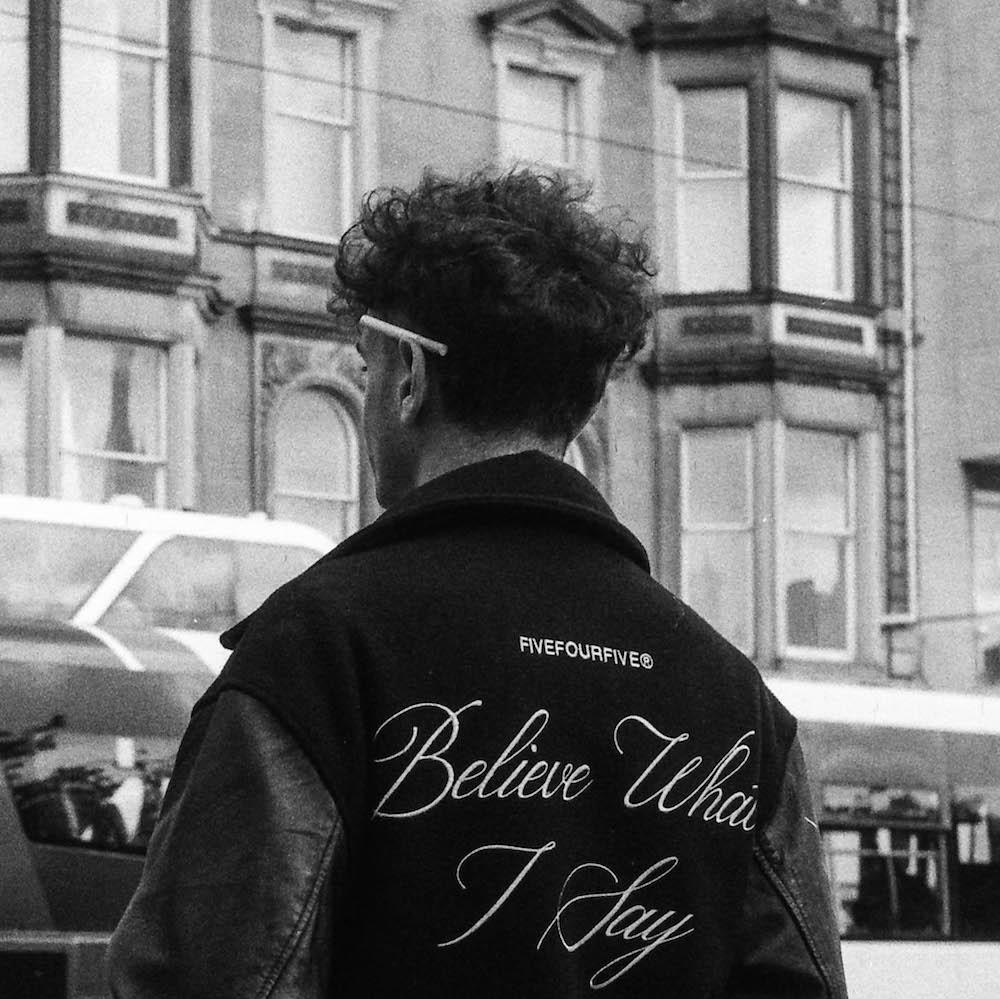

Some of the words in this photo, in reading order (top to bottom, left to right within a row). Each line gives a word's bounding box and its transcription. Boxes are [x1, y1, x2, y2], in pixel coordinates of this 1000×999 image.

[371, 700, 594, 820] Believe
[437, 841, 556, 947] I
[537, 857, 694, 990] Say
